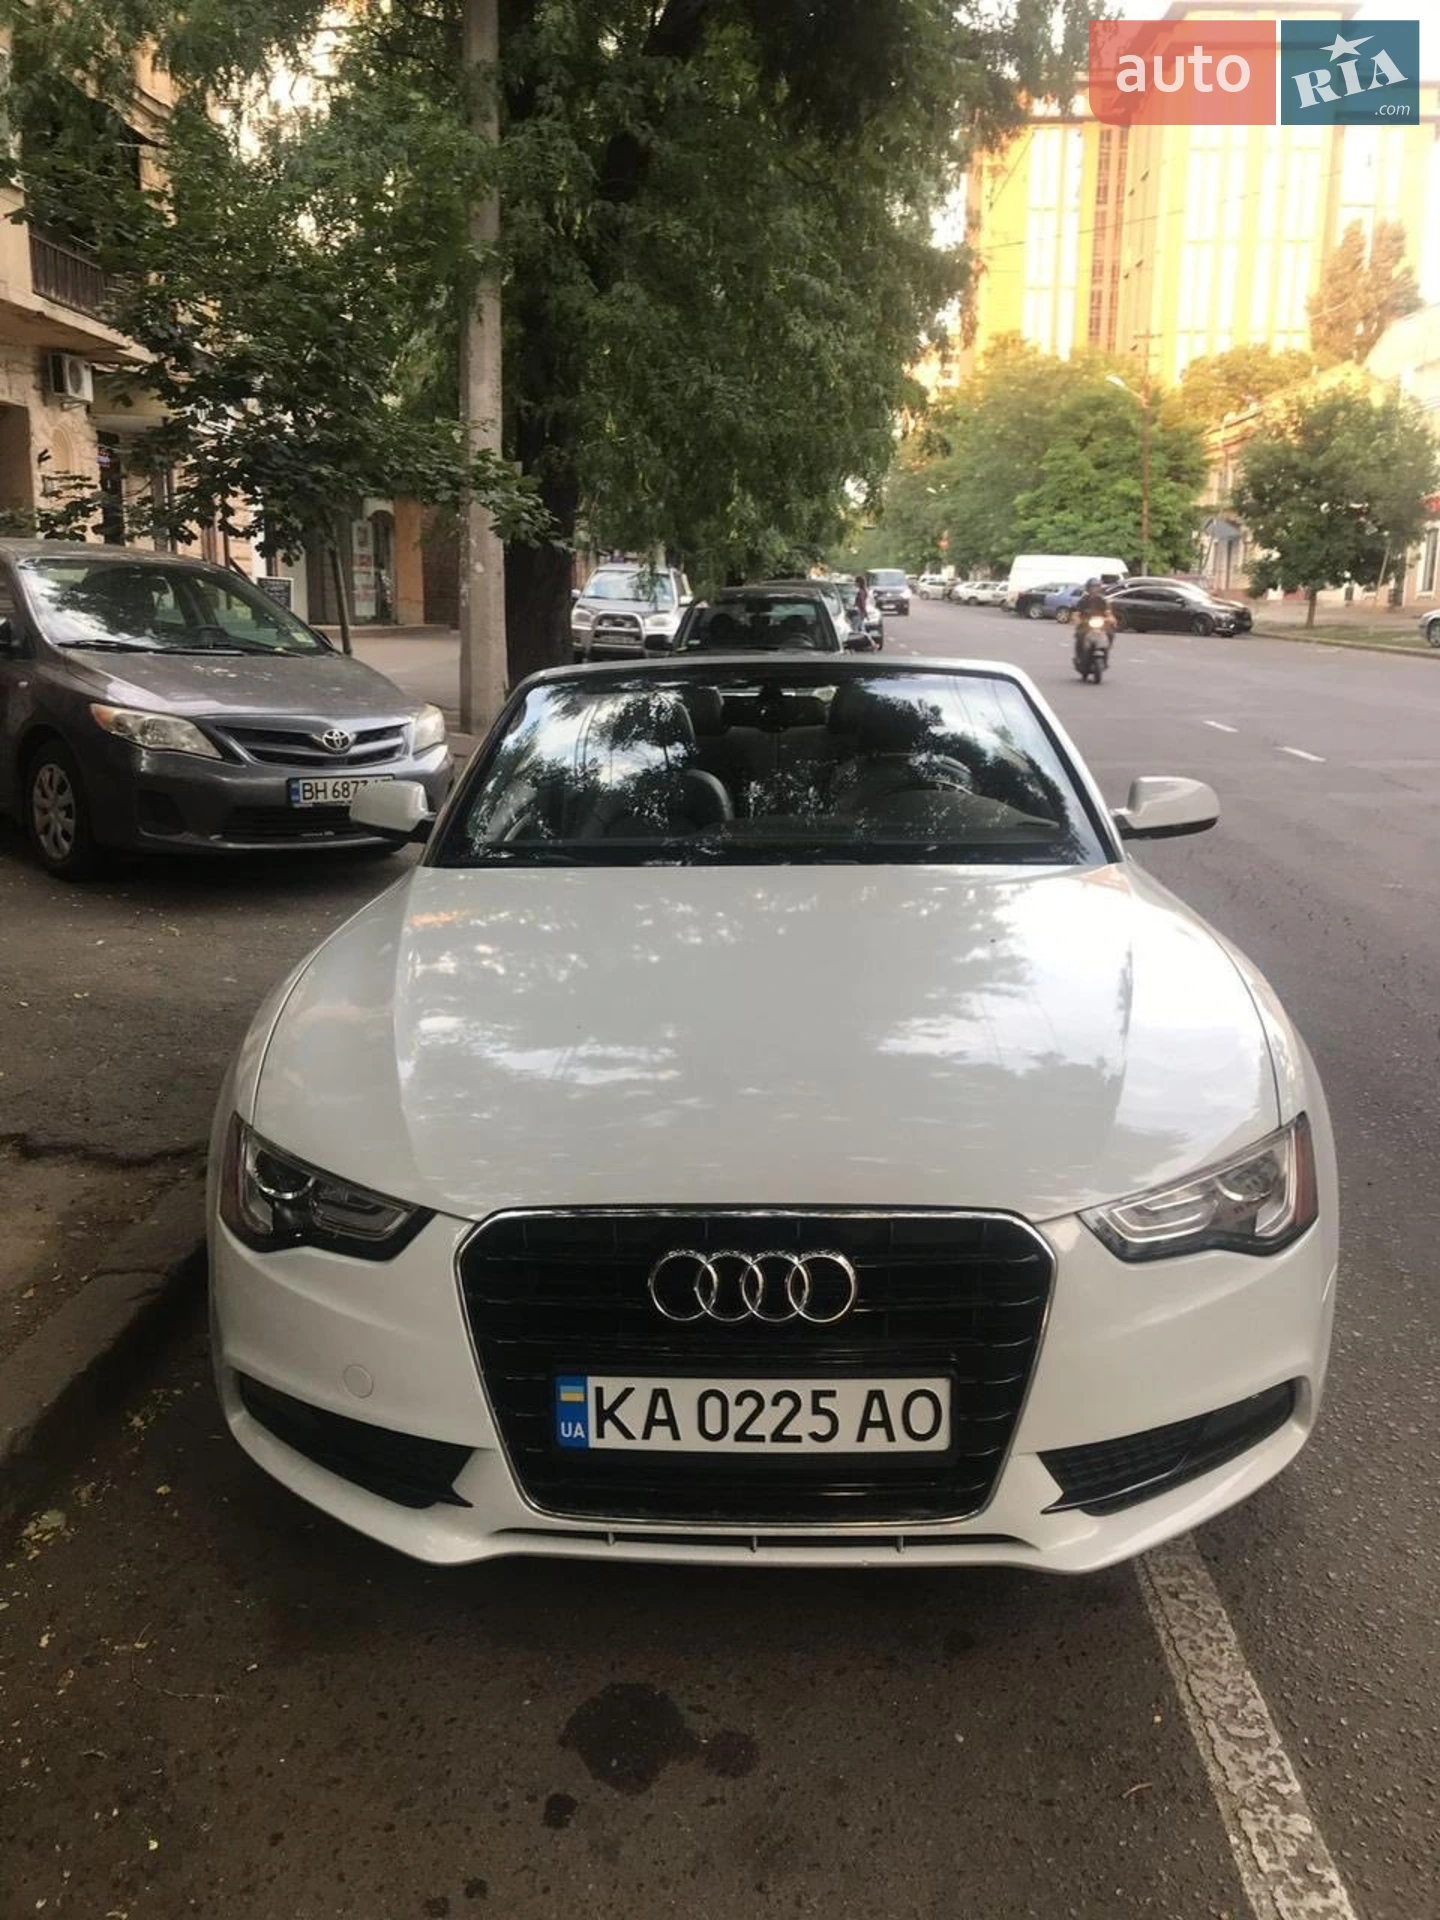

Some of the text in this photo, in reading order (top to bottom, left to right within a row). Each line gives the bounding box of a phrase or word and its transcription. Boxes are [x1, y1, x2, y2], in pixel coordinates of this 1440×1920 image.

[302, 782, 328, 801] BH
[594, 1386, 943, 1443] KA 0225 AO
[561, 1422, 586, 1439] UA
